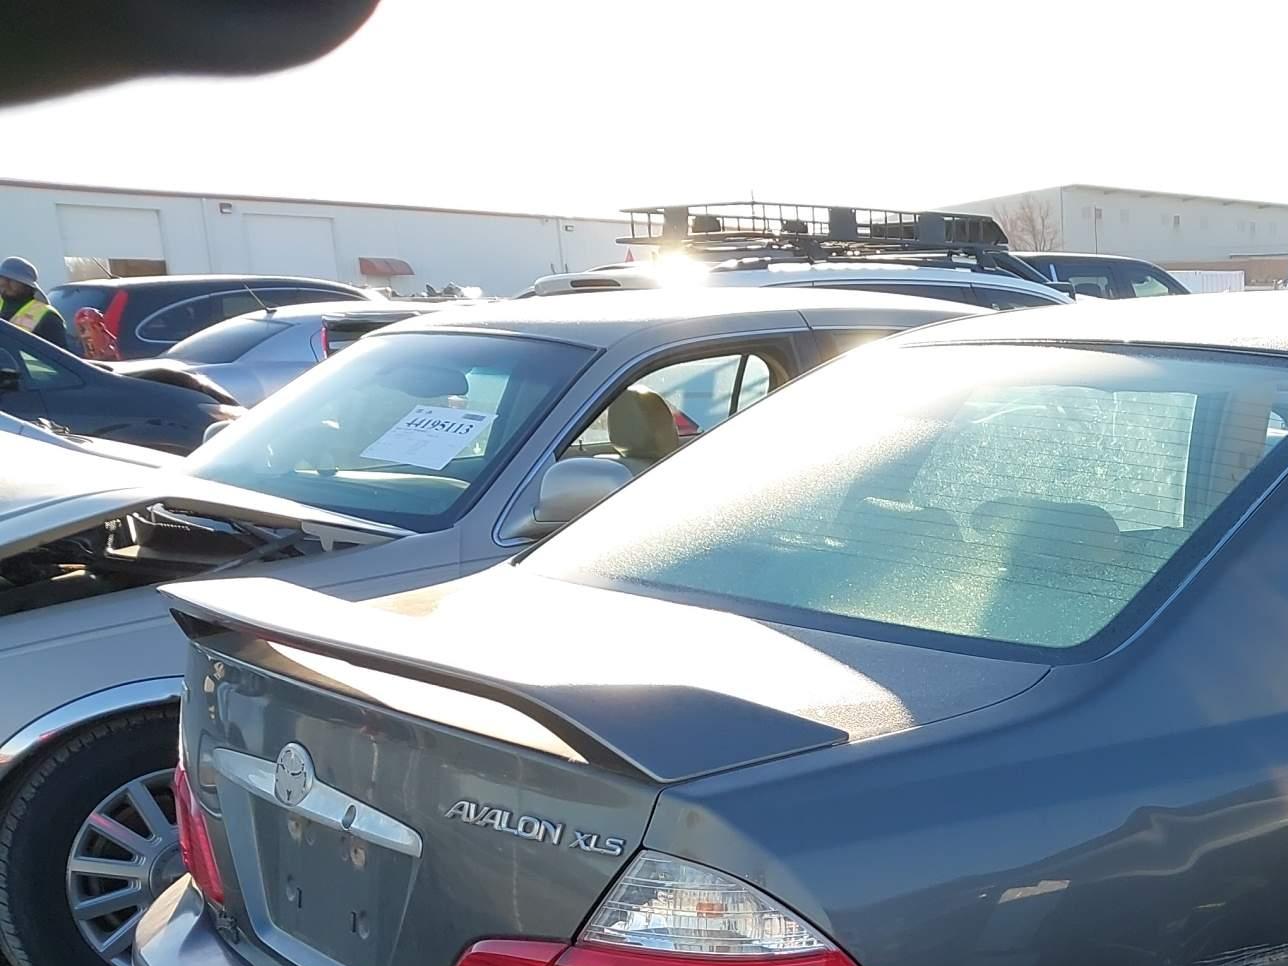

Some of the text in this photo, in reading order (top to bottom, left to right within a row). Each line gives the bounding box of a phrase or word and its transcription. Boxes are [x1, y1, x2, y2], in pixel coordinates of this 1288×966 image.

[405, 418, 474, 434] 44195113
[444, 799, 626, 857] AVALON XLS
